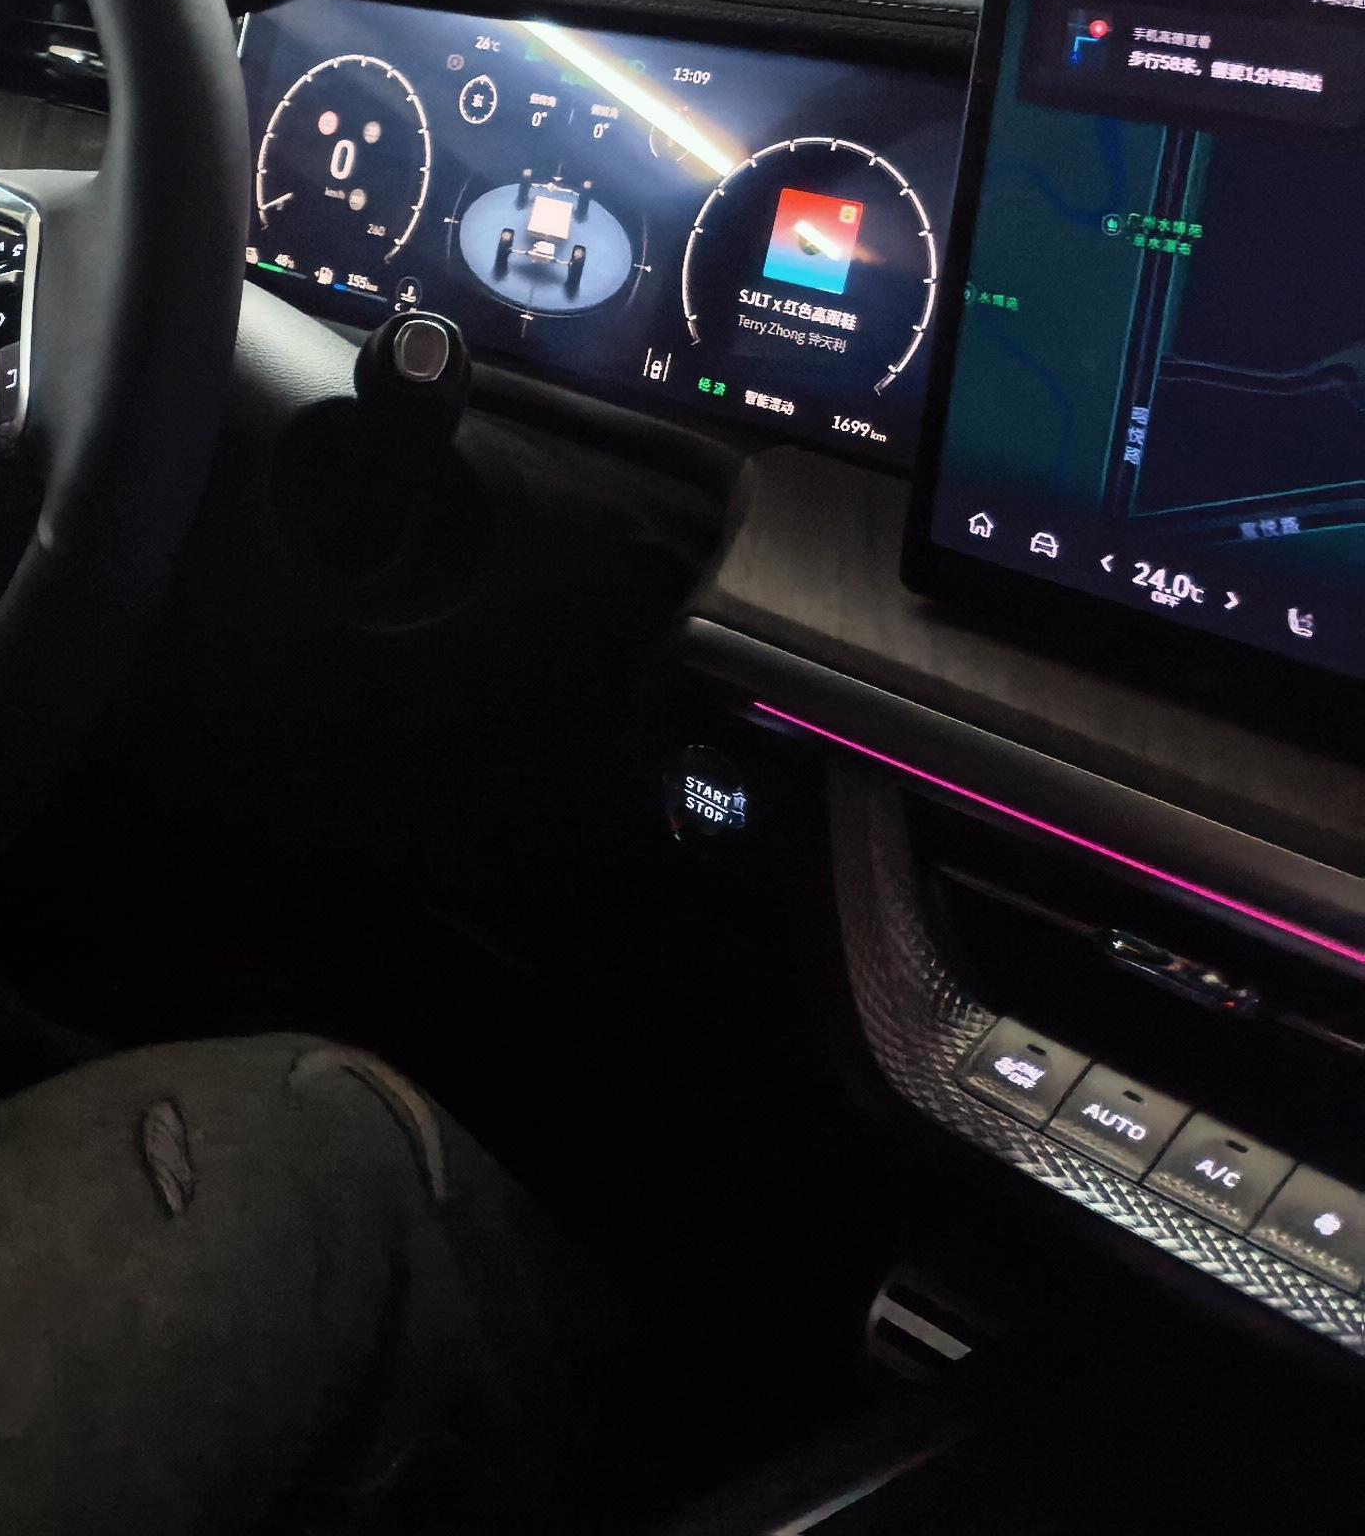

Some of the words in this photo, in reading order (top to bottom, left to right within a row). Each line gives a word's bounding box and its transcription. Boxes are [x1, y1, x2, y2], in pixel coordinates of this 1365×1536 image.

[672, 66, 711, 86] 13:09
[329, 139, 355, 180] 0
[738, 288, 773, 309] SJLT
[737, 314, 768, 335] Terry
[766, 321, 806, 346] Zhong
[685, 776, 731, 807] START
[685, 796, 724, 822] STOP
[1081, 1102, 1147, 1141] AUTO
[1194, 1158, 1242, 1188] A/C
